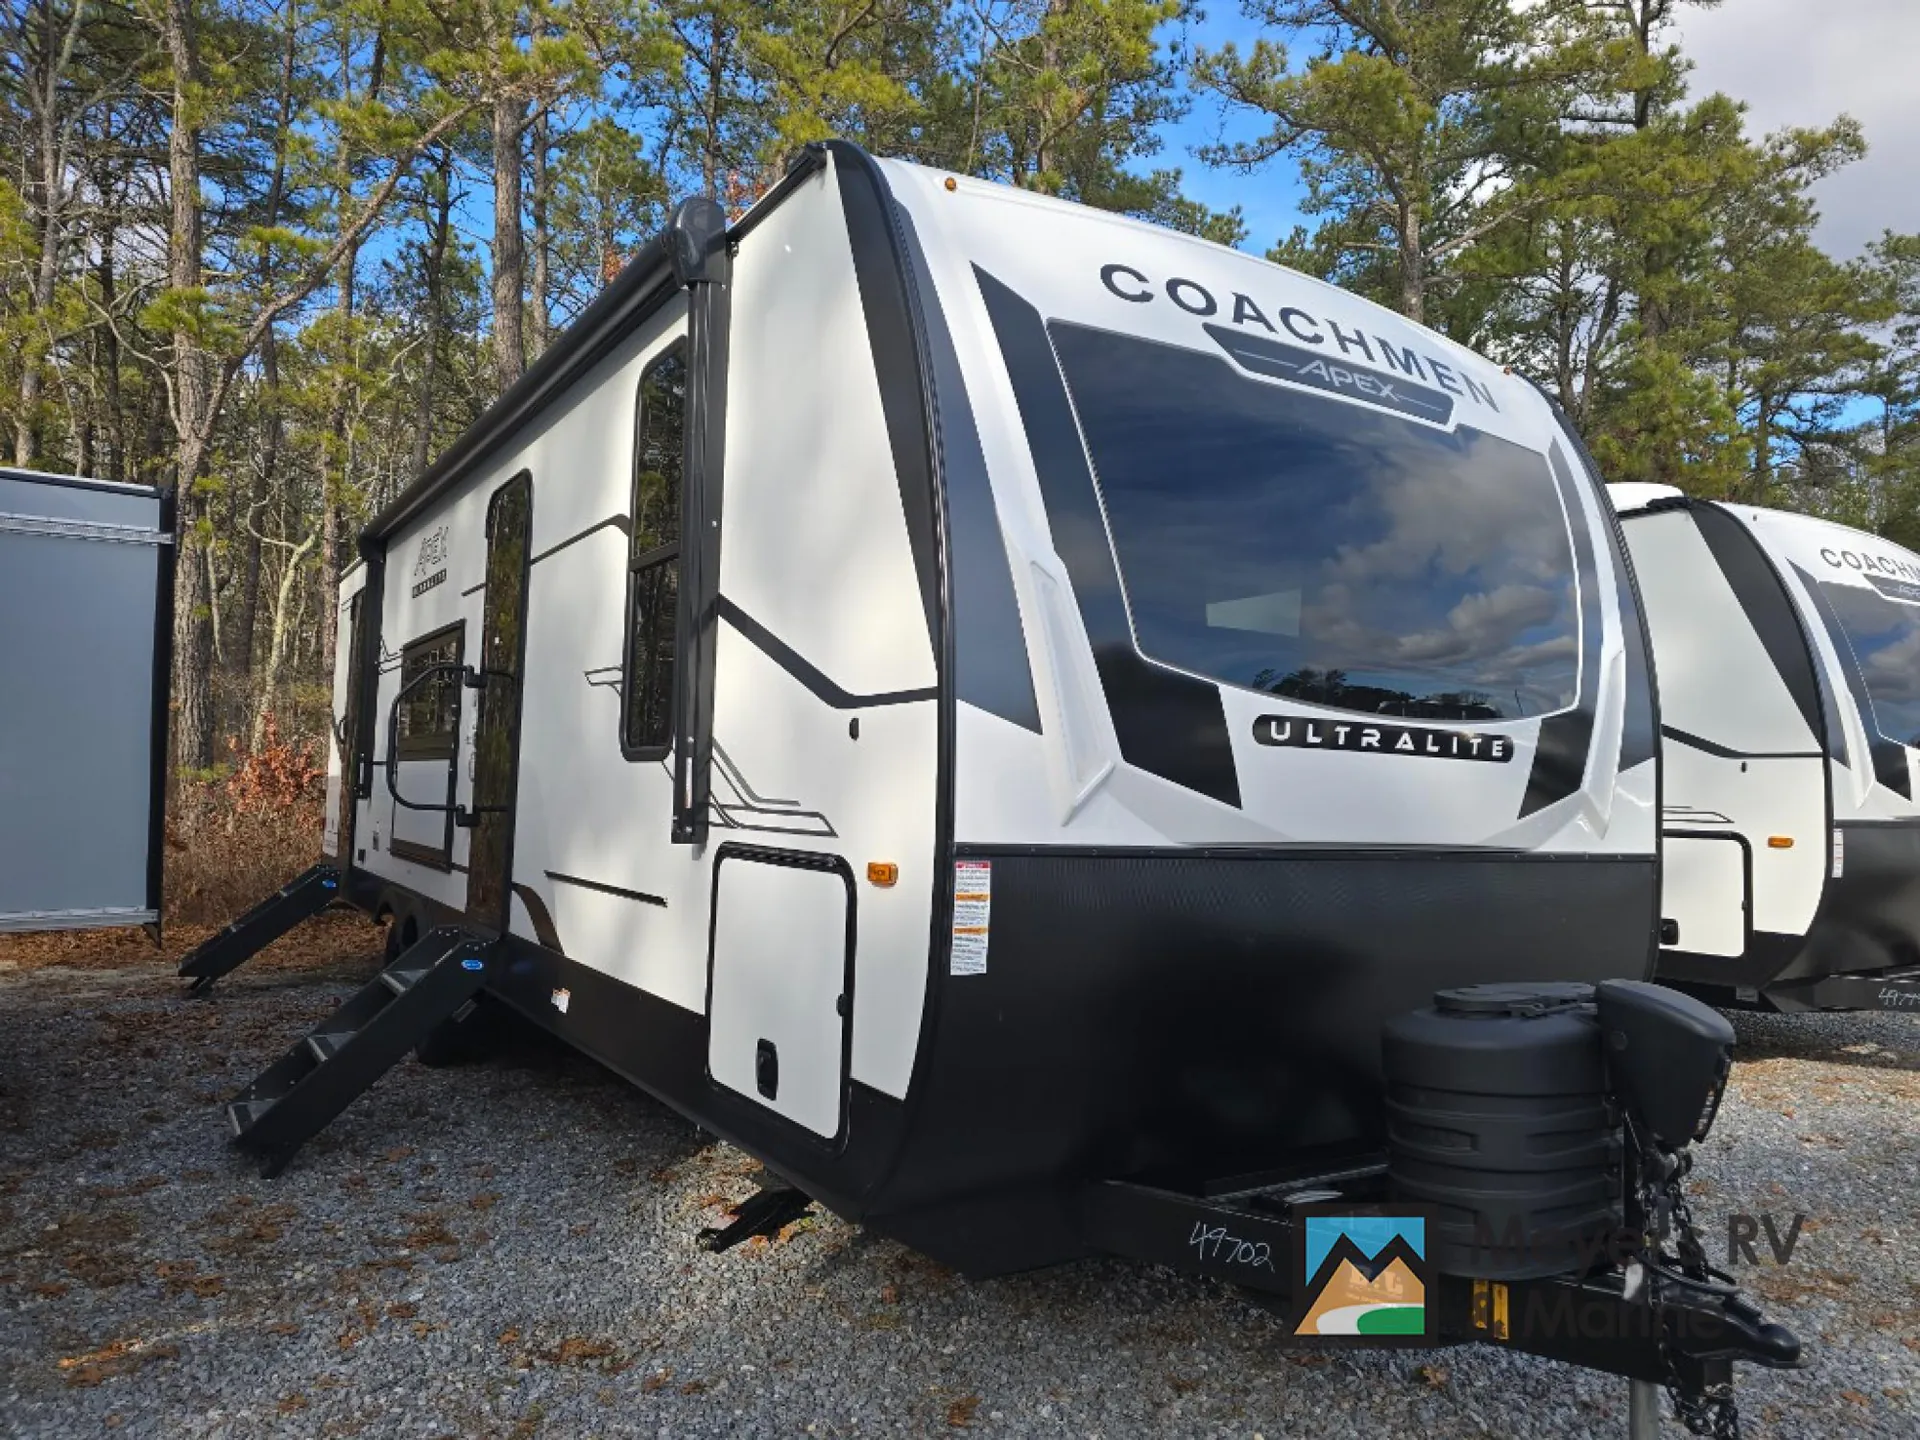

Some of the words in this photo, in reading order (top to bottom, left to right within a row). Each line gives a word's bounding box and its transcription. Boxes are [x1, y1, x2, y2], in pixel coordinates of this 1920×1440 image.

[1099, 263, 1500, 413] COACHMEN
[1298, 359, 1399, 401] APEX
[1269, 720, 1504, 757] ULTRALITE
[1189, 1220, 1275, 1274] 49702
